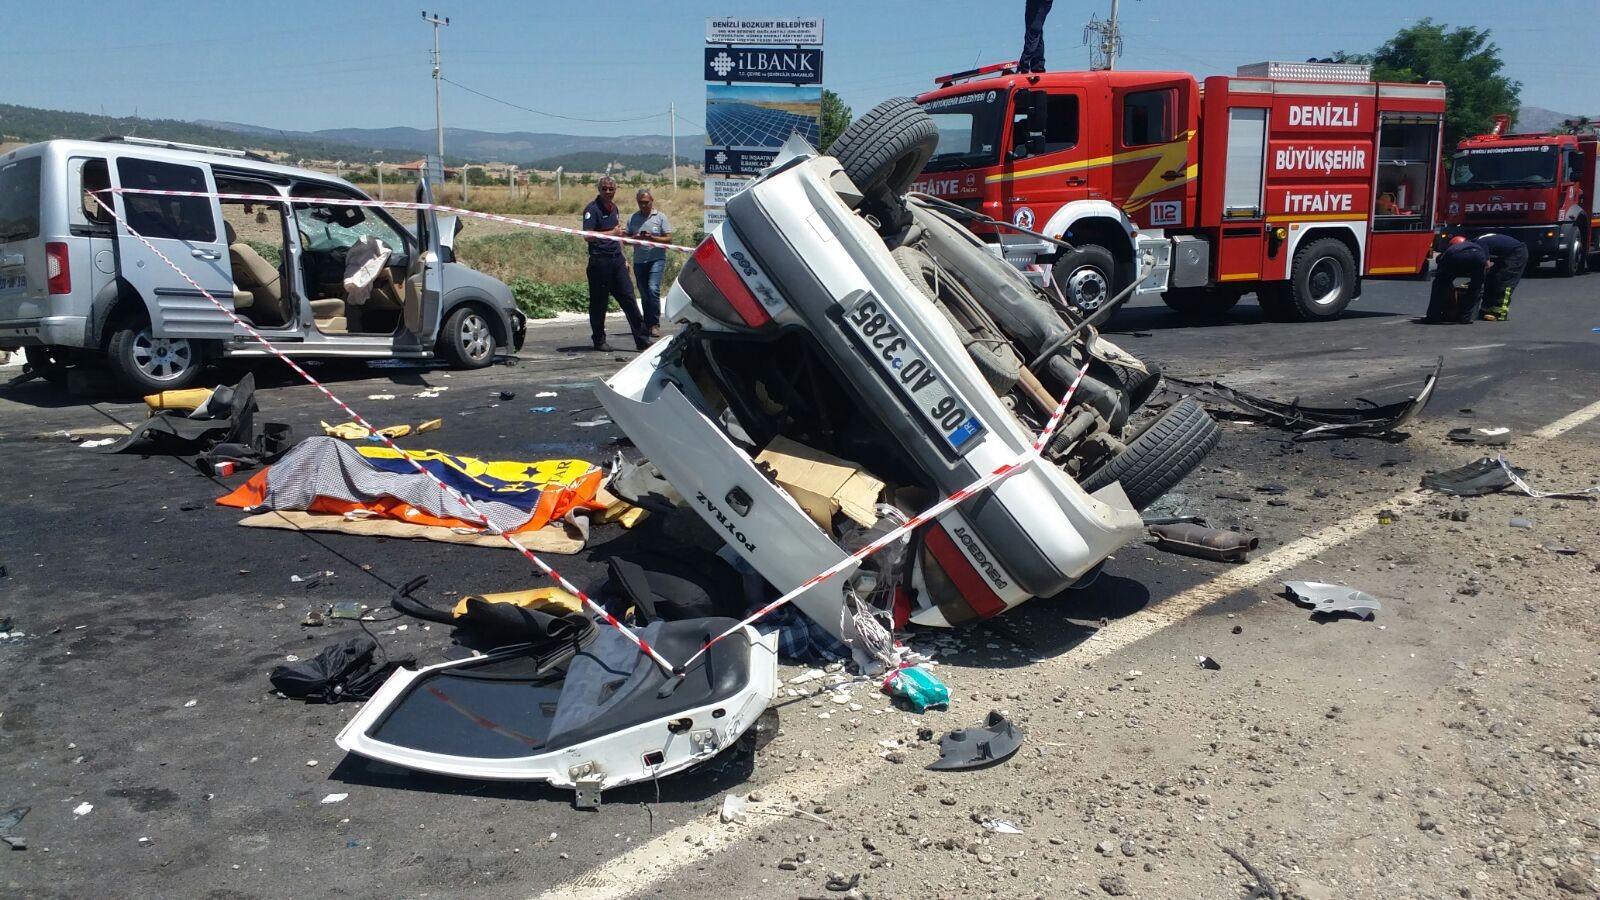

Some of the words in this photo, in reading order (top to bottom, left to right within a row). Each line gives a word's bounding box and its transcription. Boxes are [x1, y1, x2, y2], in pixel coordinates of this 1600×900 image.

[712, 20, 740, 28] DENİZLİ
[776, 20, 816, 28] BELEDİYESİ
[1289, 102, 1359, 126] DENİZLİ
[1275, 146, 1365, 174] BÜYÜKŞEHİR
[1154, 205, 1177, 219] 112
[1284, 190, 1353, 213] İTFAİYE
[851, 301, 907, 361] 3285
[900, 358, 937, 393] AD
[931, 396, 967, 431] 06
[963, 422, 977, 435] TR
[696, 491, 757, 553] POYRAZ
[953, 527, 1008, 590] PEUGEOT
